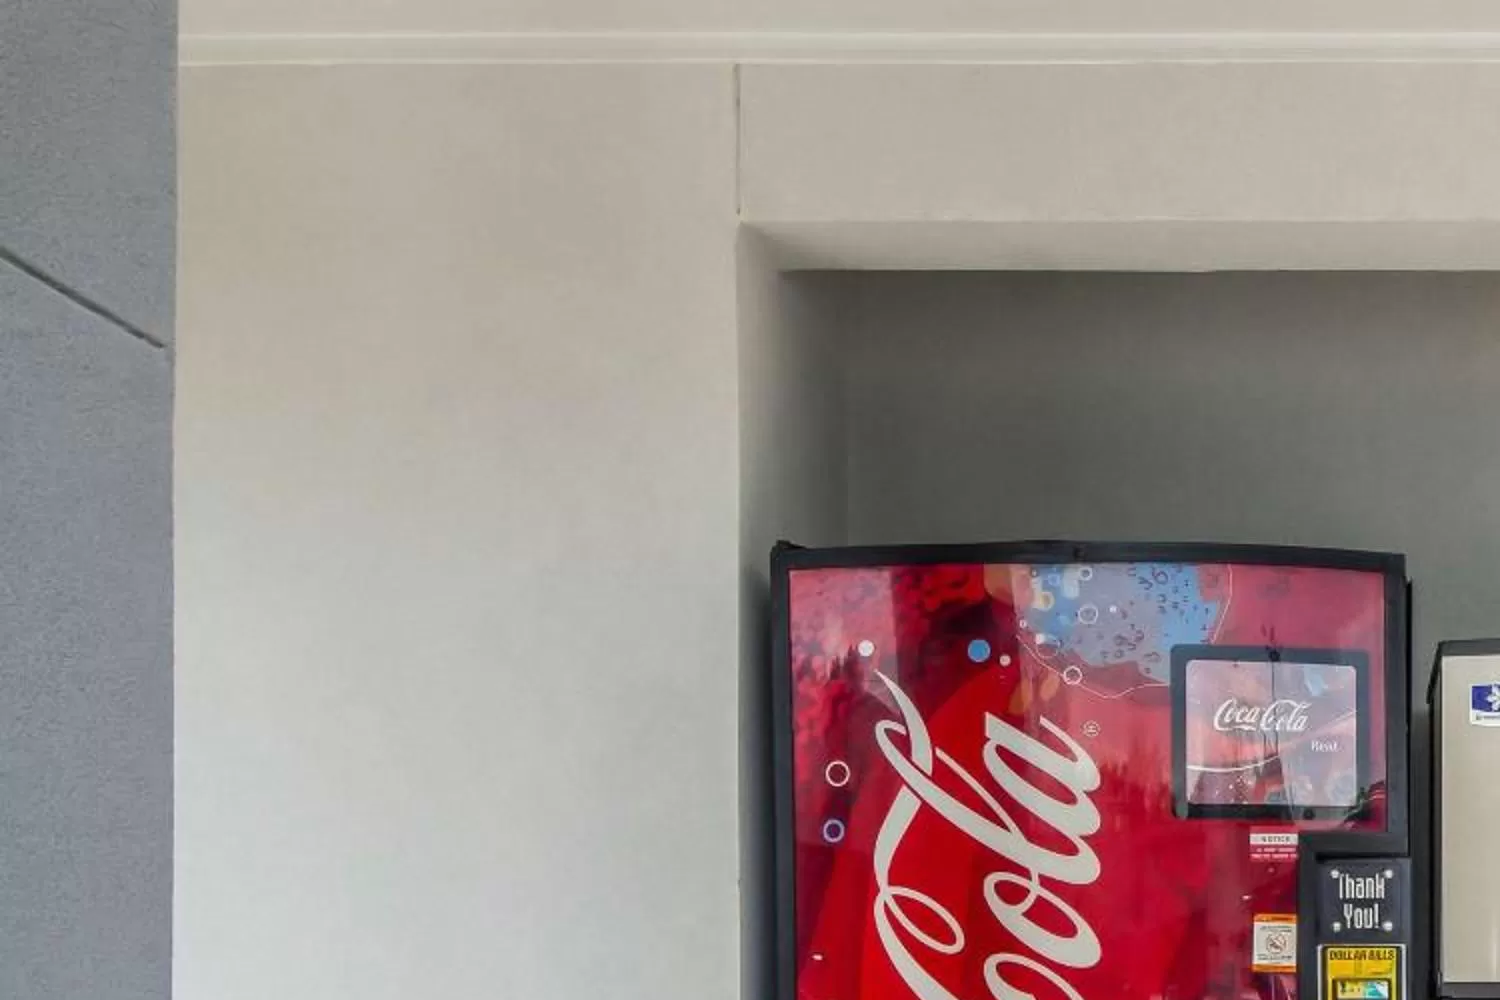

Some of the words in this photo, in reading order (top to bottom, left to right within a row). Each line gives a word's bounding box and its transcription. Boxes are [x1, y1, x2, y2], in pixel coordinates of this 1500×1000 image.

[1213, 697, 1312, 732] Coca-Cola
[1339, 873, 1385, 899] Thank
[1343, 903, 1379, 929] You!
[1329, 949, 1367, 961] DOLLAR
[1368, 949, 1395, 961] BILLS
